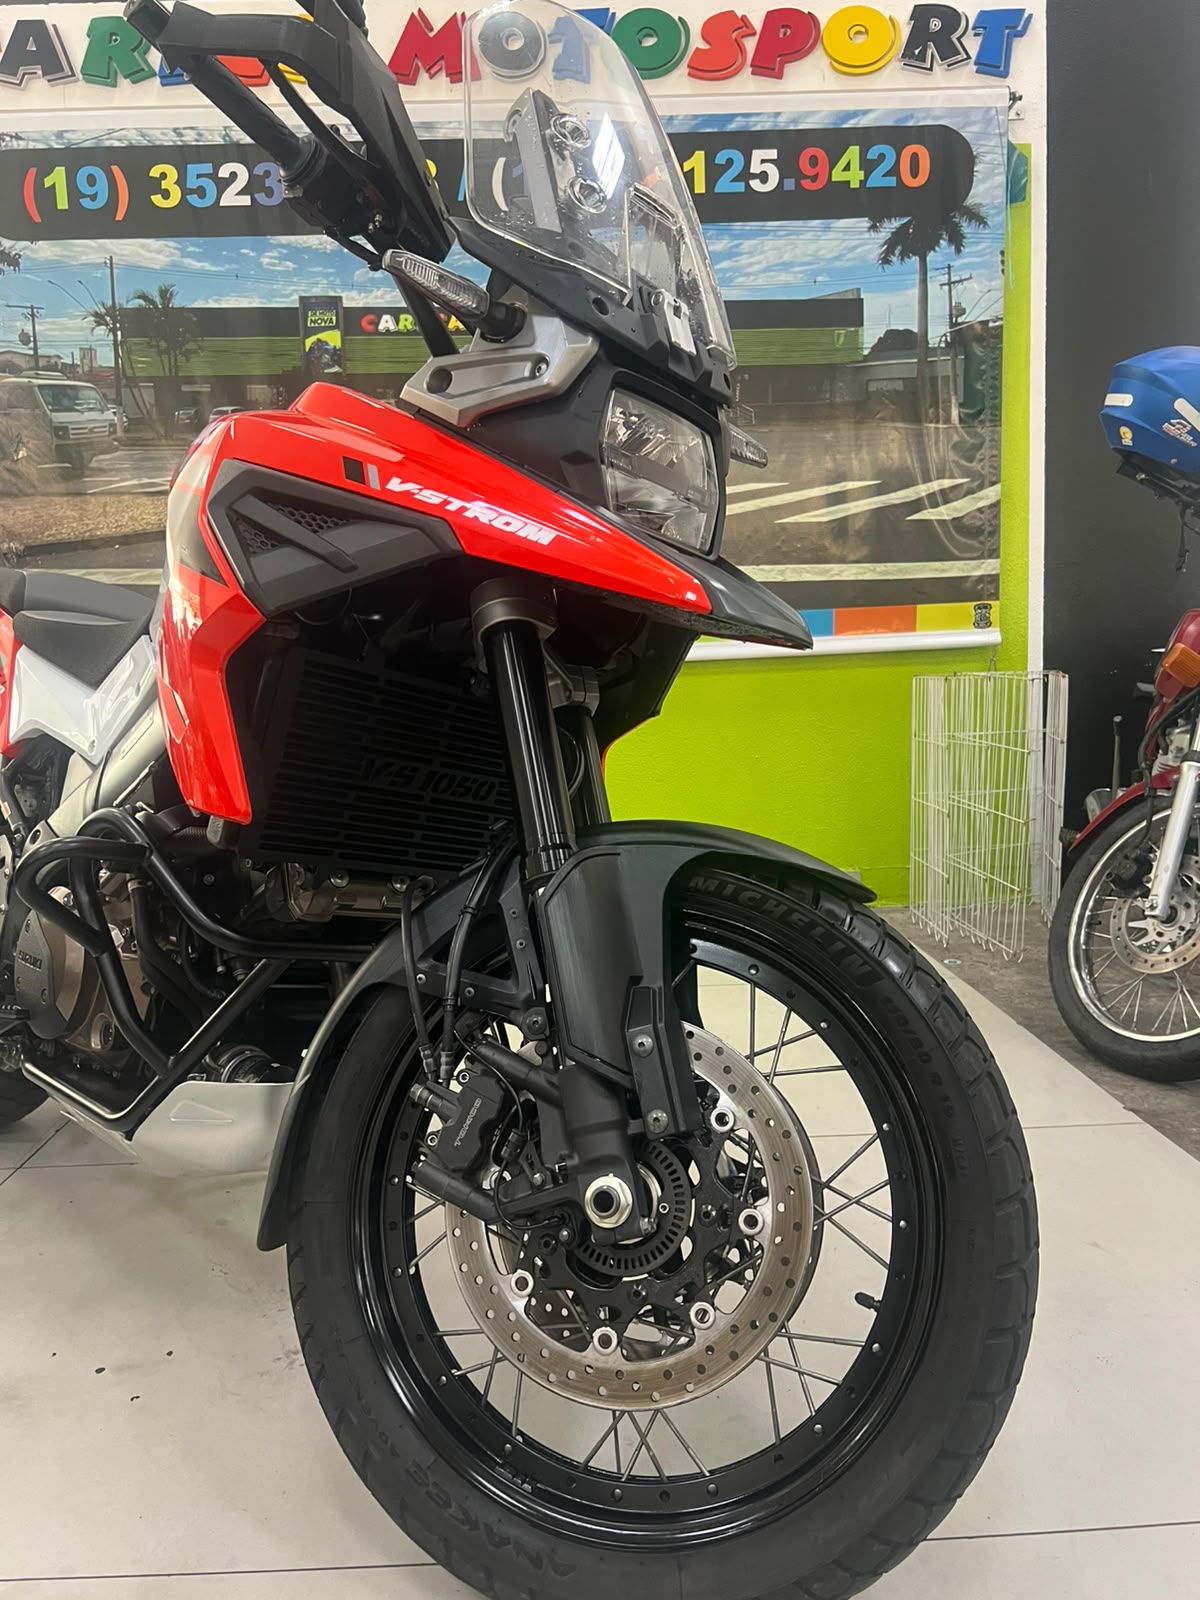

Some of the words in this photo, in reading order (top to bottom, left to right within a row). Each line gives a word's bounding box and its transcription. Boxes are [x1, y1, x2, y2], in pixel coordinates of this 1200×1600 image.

[24, 164, 130, 223] (19)
[641, 144, 931, 195] 125.9420
[385, 476, 558, 546] V-STROM
[688, 875, 887, 989] MICHELIN
